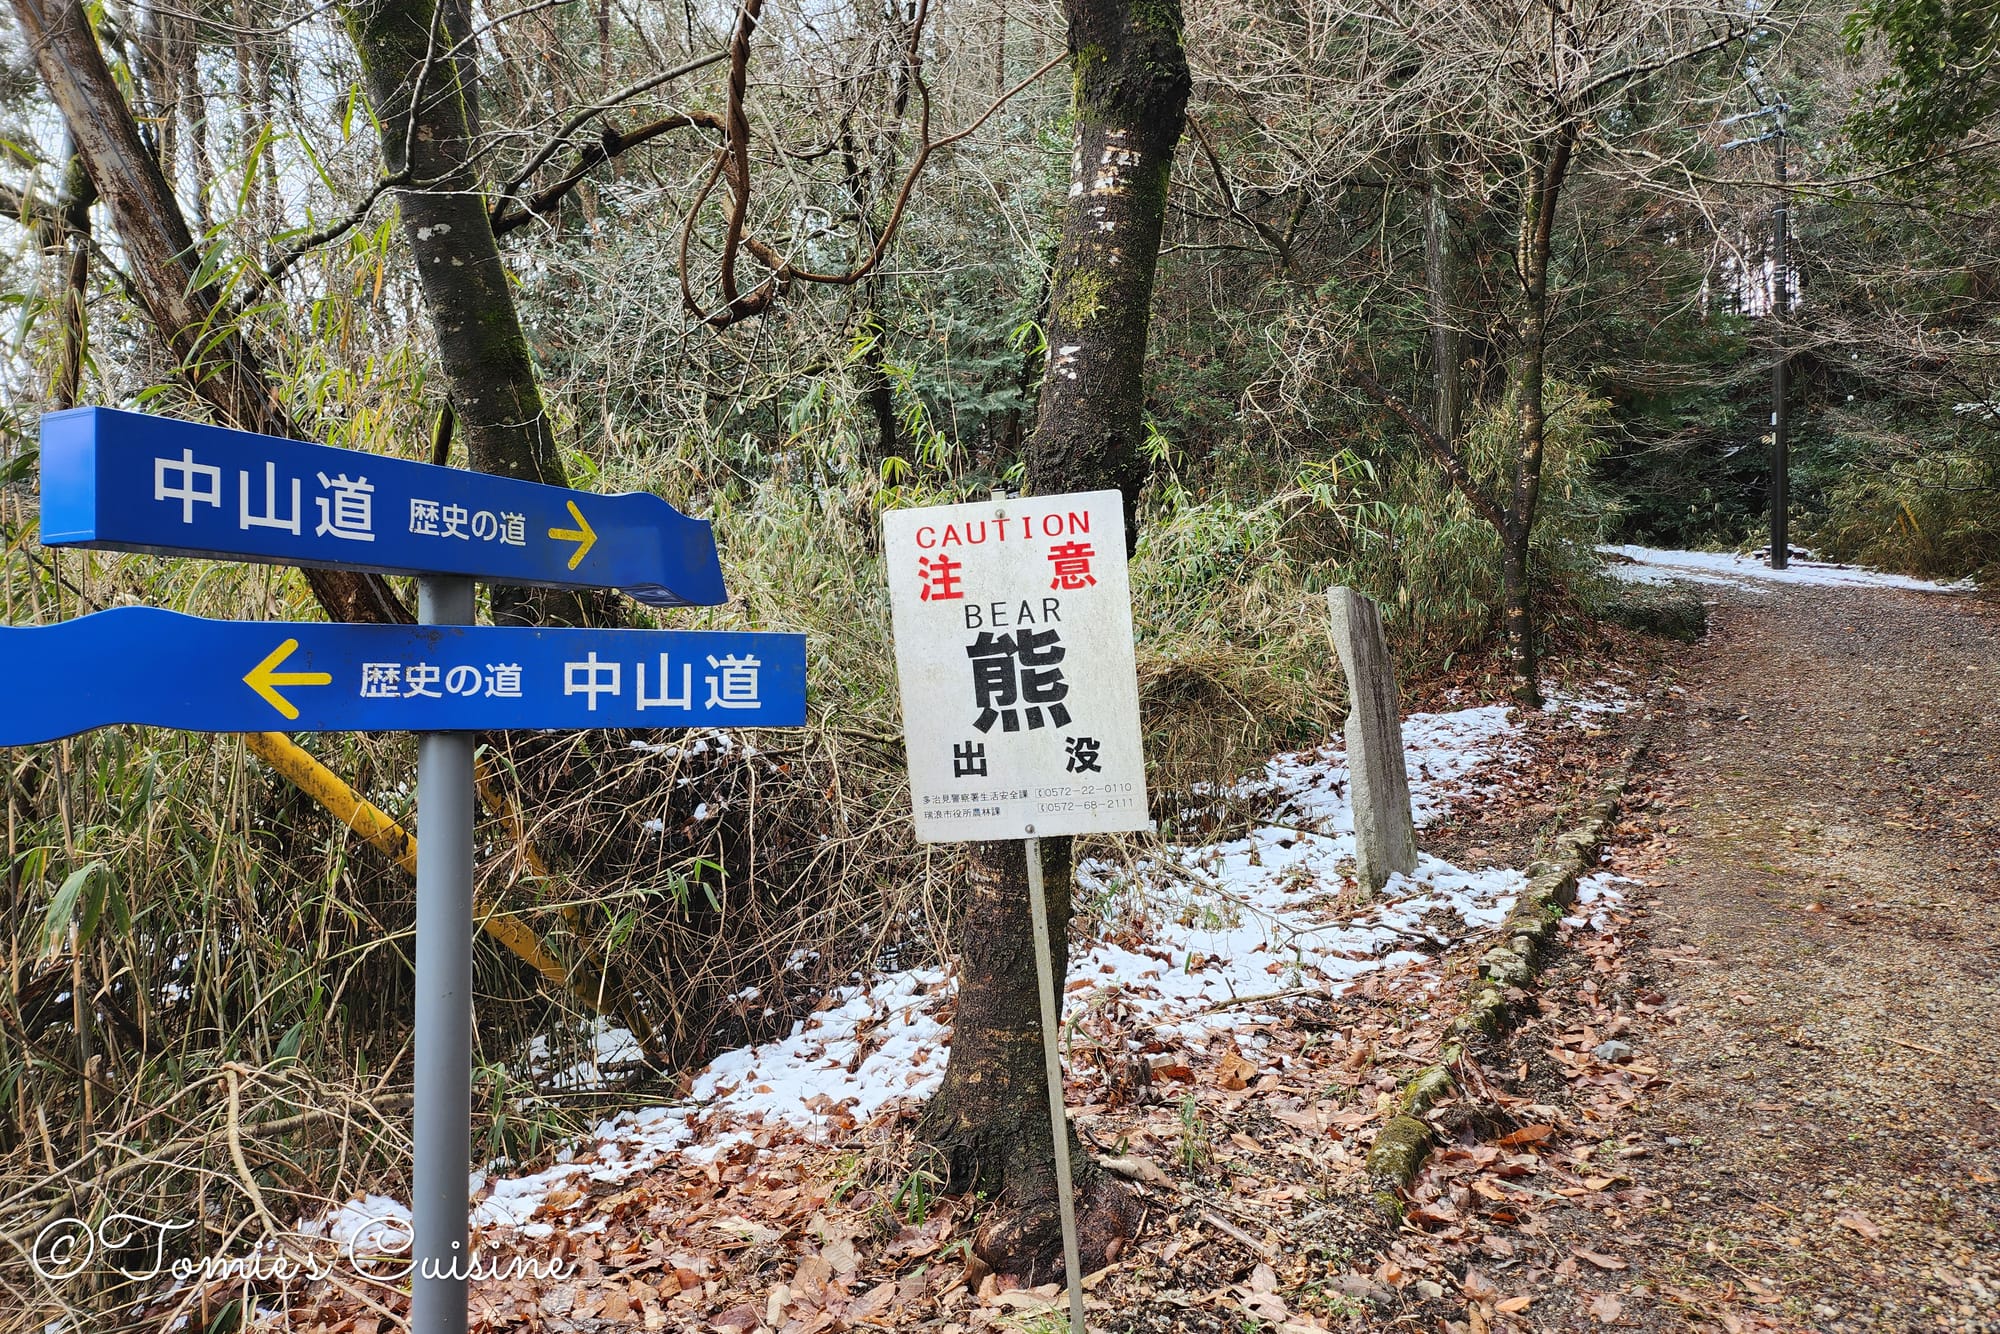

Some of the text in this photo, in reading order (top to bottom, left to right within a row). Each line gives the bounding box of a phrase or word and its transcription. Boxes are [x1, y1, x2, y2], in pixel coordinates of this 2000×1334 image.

[154, 448, 527, 547] 中山道 歴史の道
[915, 510, 1091, 549] CAUTION
[964, 597, 1061, 629] BEAR
[360, 651, 763, 712] 歴史の道 中山道
[966, 628, 1072, 733] 熊
